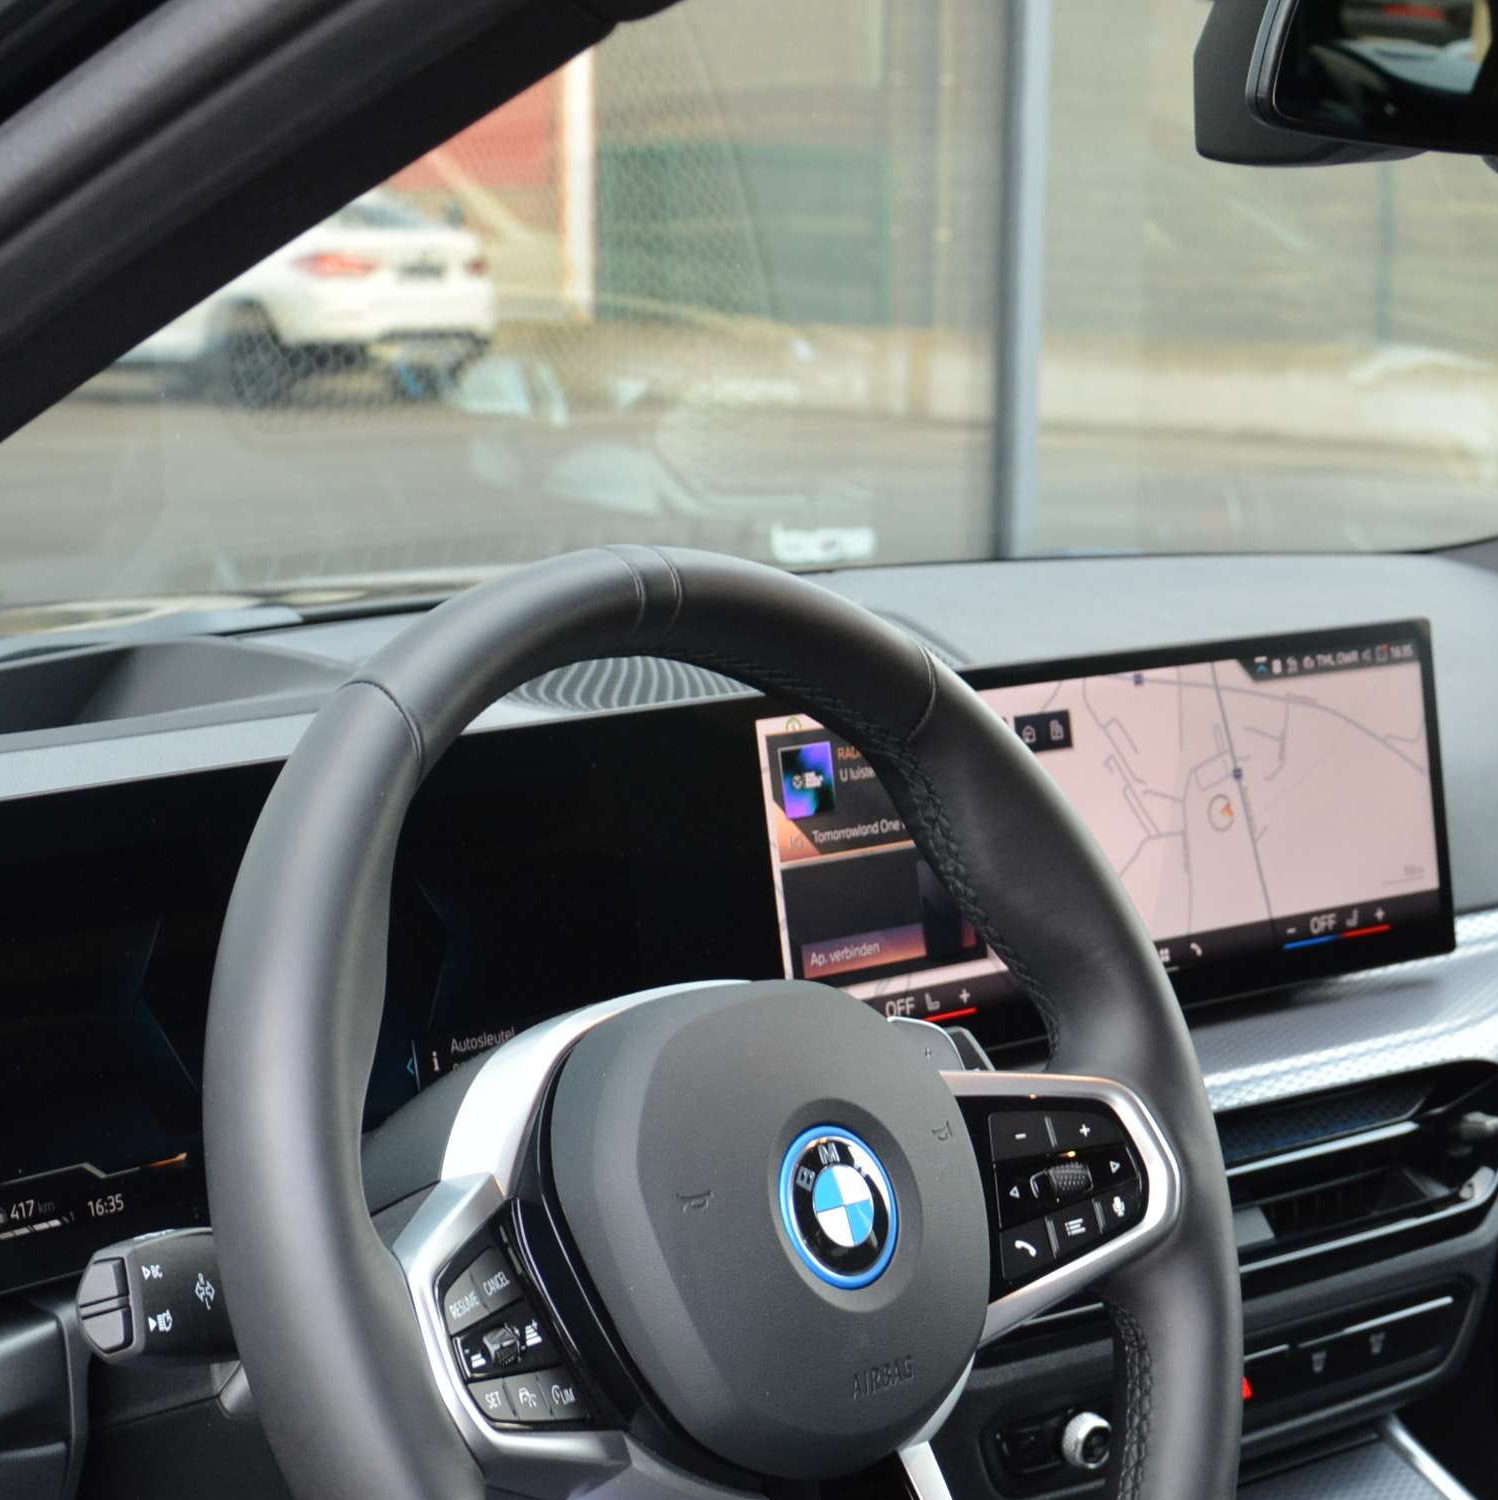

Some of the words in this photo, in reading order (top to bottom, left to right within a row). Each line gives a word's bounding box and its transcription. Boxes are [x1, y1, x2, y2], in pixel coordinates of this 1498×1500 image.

[812, 819, 879, 844] Tomorrowland
[880, 817, 901, 834] One
[1309, 913, 1337, 934] OFF
[810, 951, 828, 968] Ap.
[829, 941, 881, 964] verbinden
[884, 996, 916, 1018] OFF
[9, 1199, 35, 1221] 417
[87, 1193, 125, 1218] 16:35
[482, 1271, 511, 1297] CANCEL
[449, 1291, 481, 1321] RESUME
[852, 1354, 917, 1401] AIRBAG
[484, 1387, 502, 1408] SET
